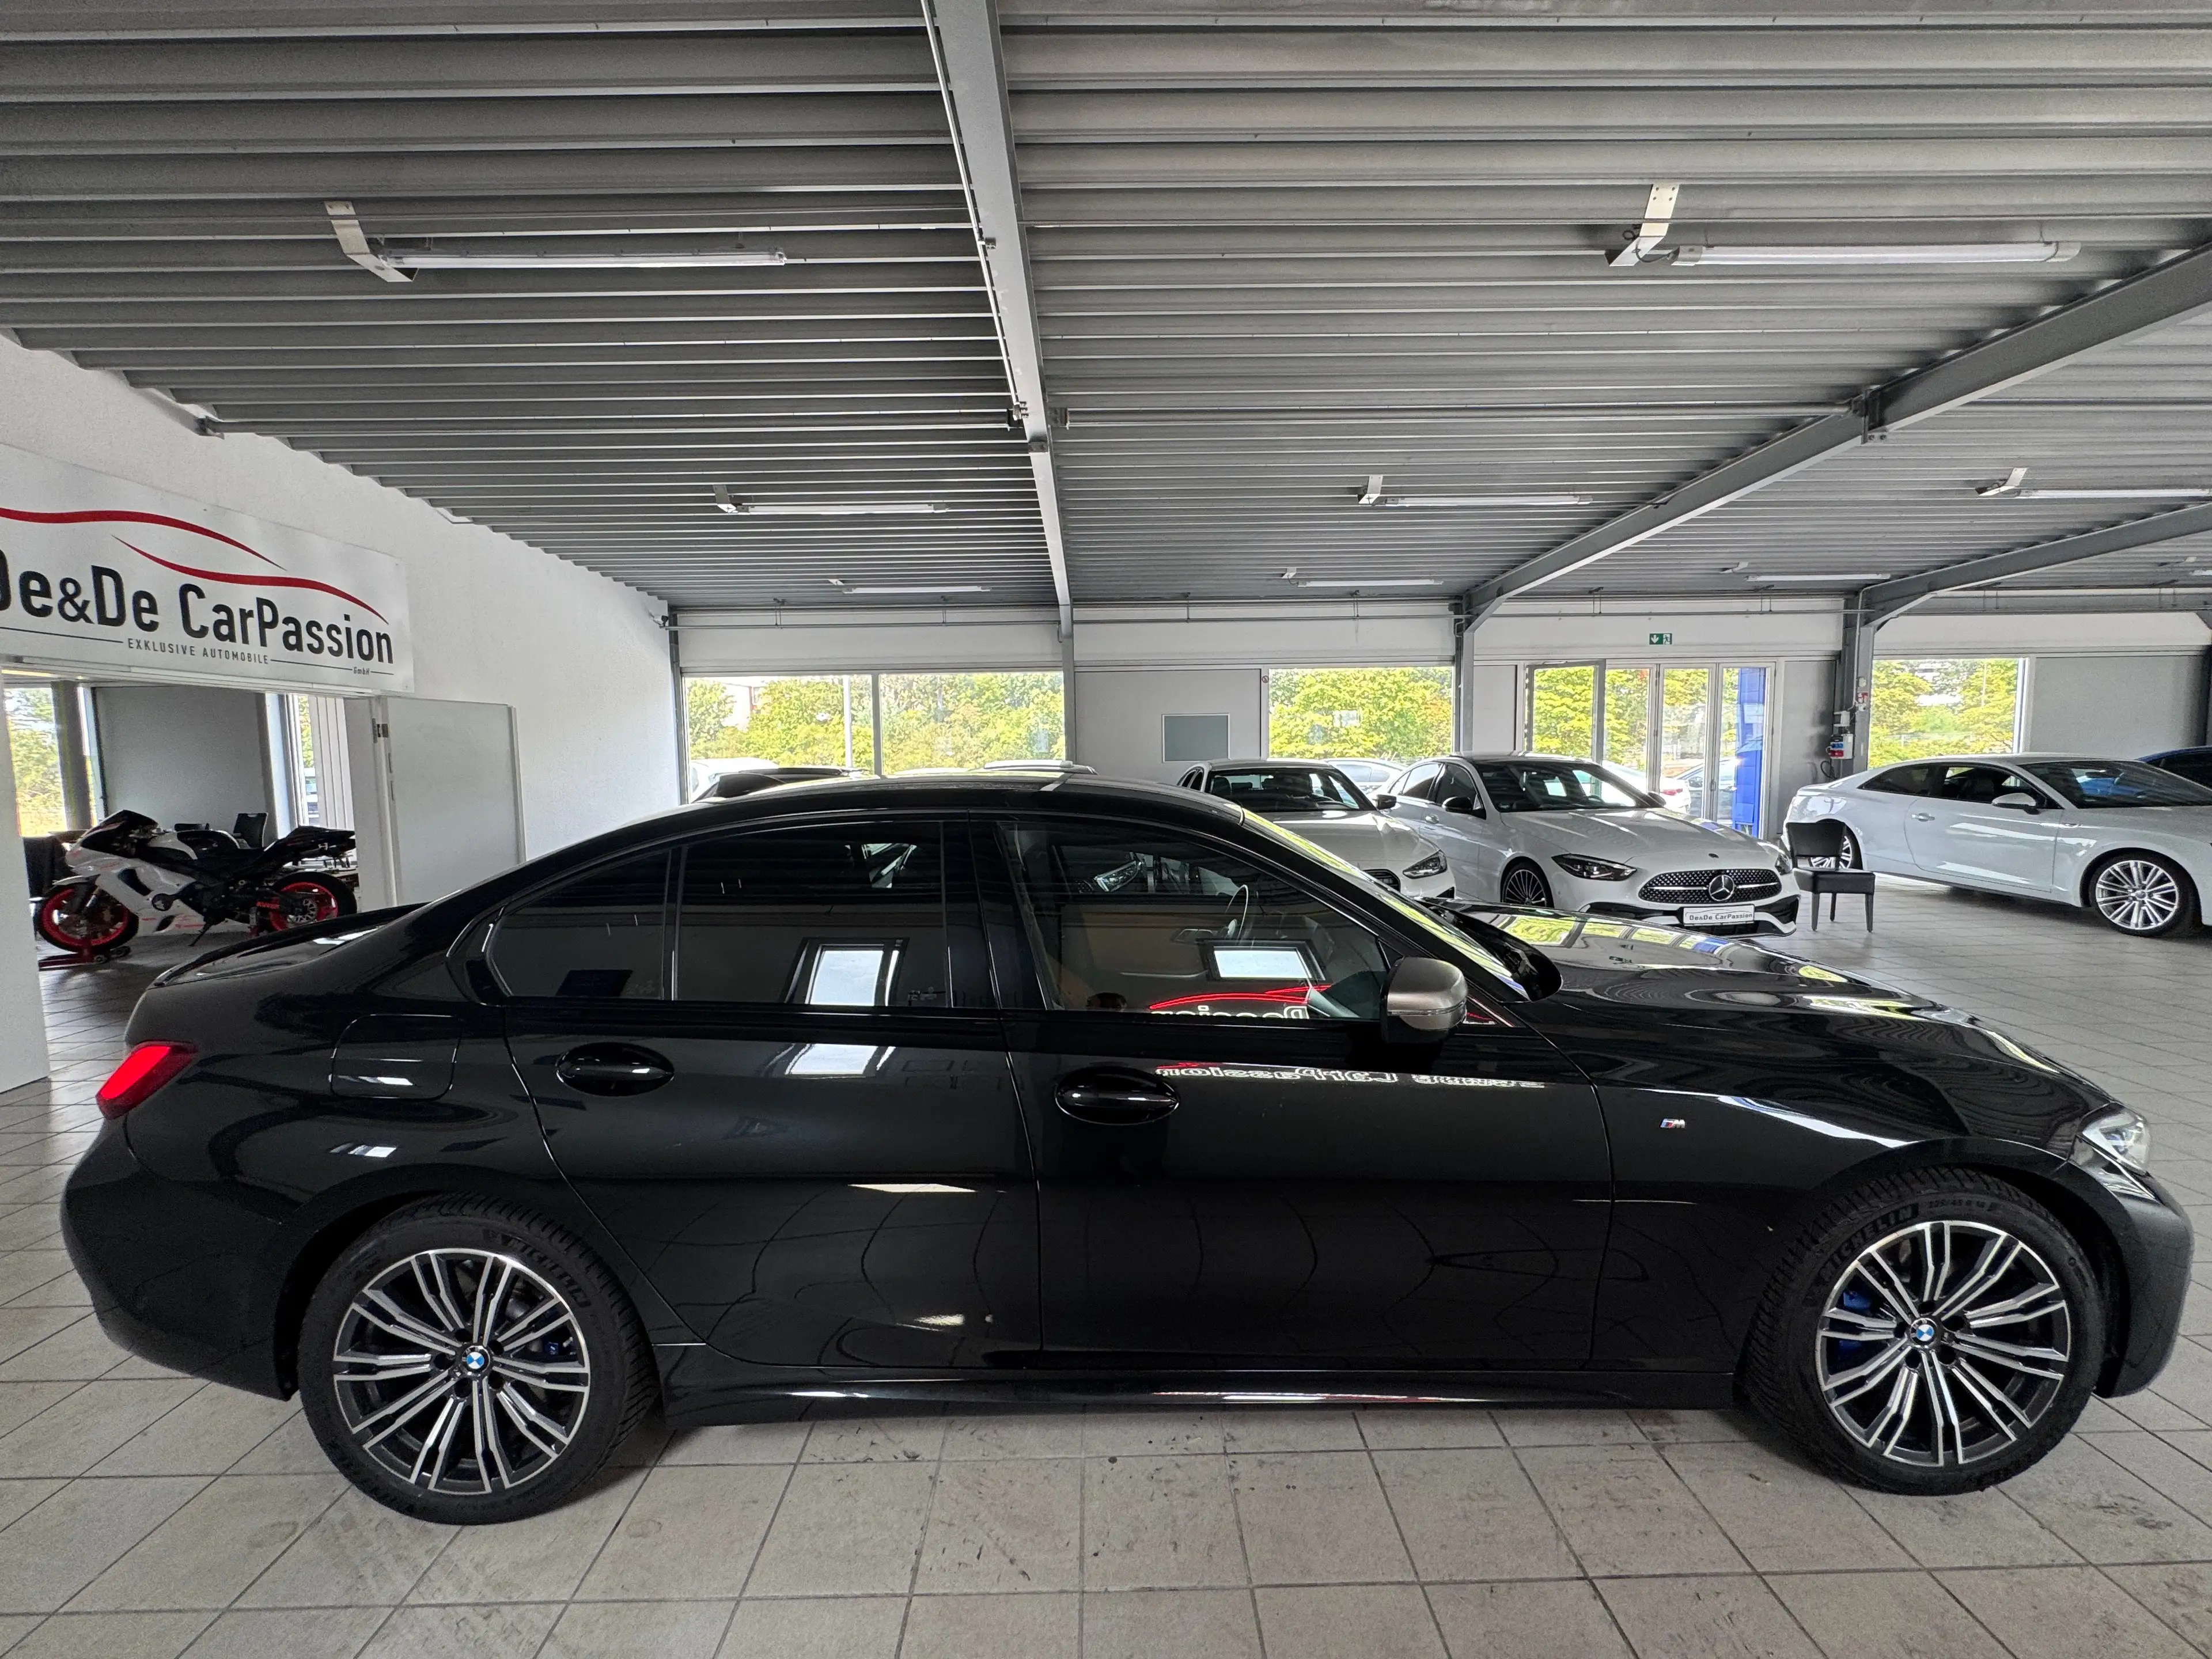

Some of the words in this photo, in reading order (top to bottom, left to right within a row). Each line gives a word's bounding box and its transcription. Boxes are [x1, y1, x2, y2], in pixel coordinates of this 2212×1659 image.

[179, 584, 393, 664] CarPassion
[128, 638, 196, 657] EXKLUSIVE
[202, 648, 269, 665] AUTOMOBILE
[353, 666, 370, 675] GmbH
[1819, 1206, 1912, 1282] MICHELIN
